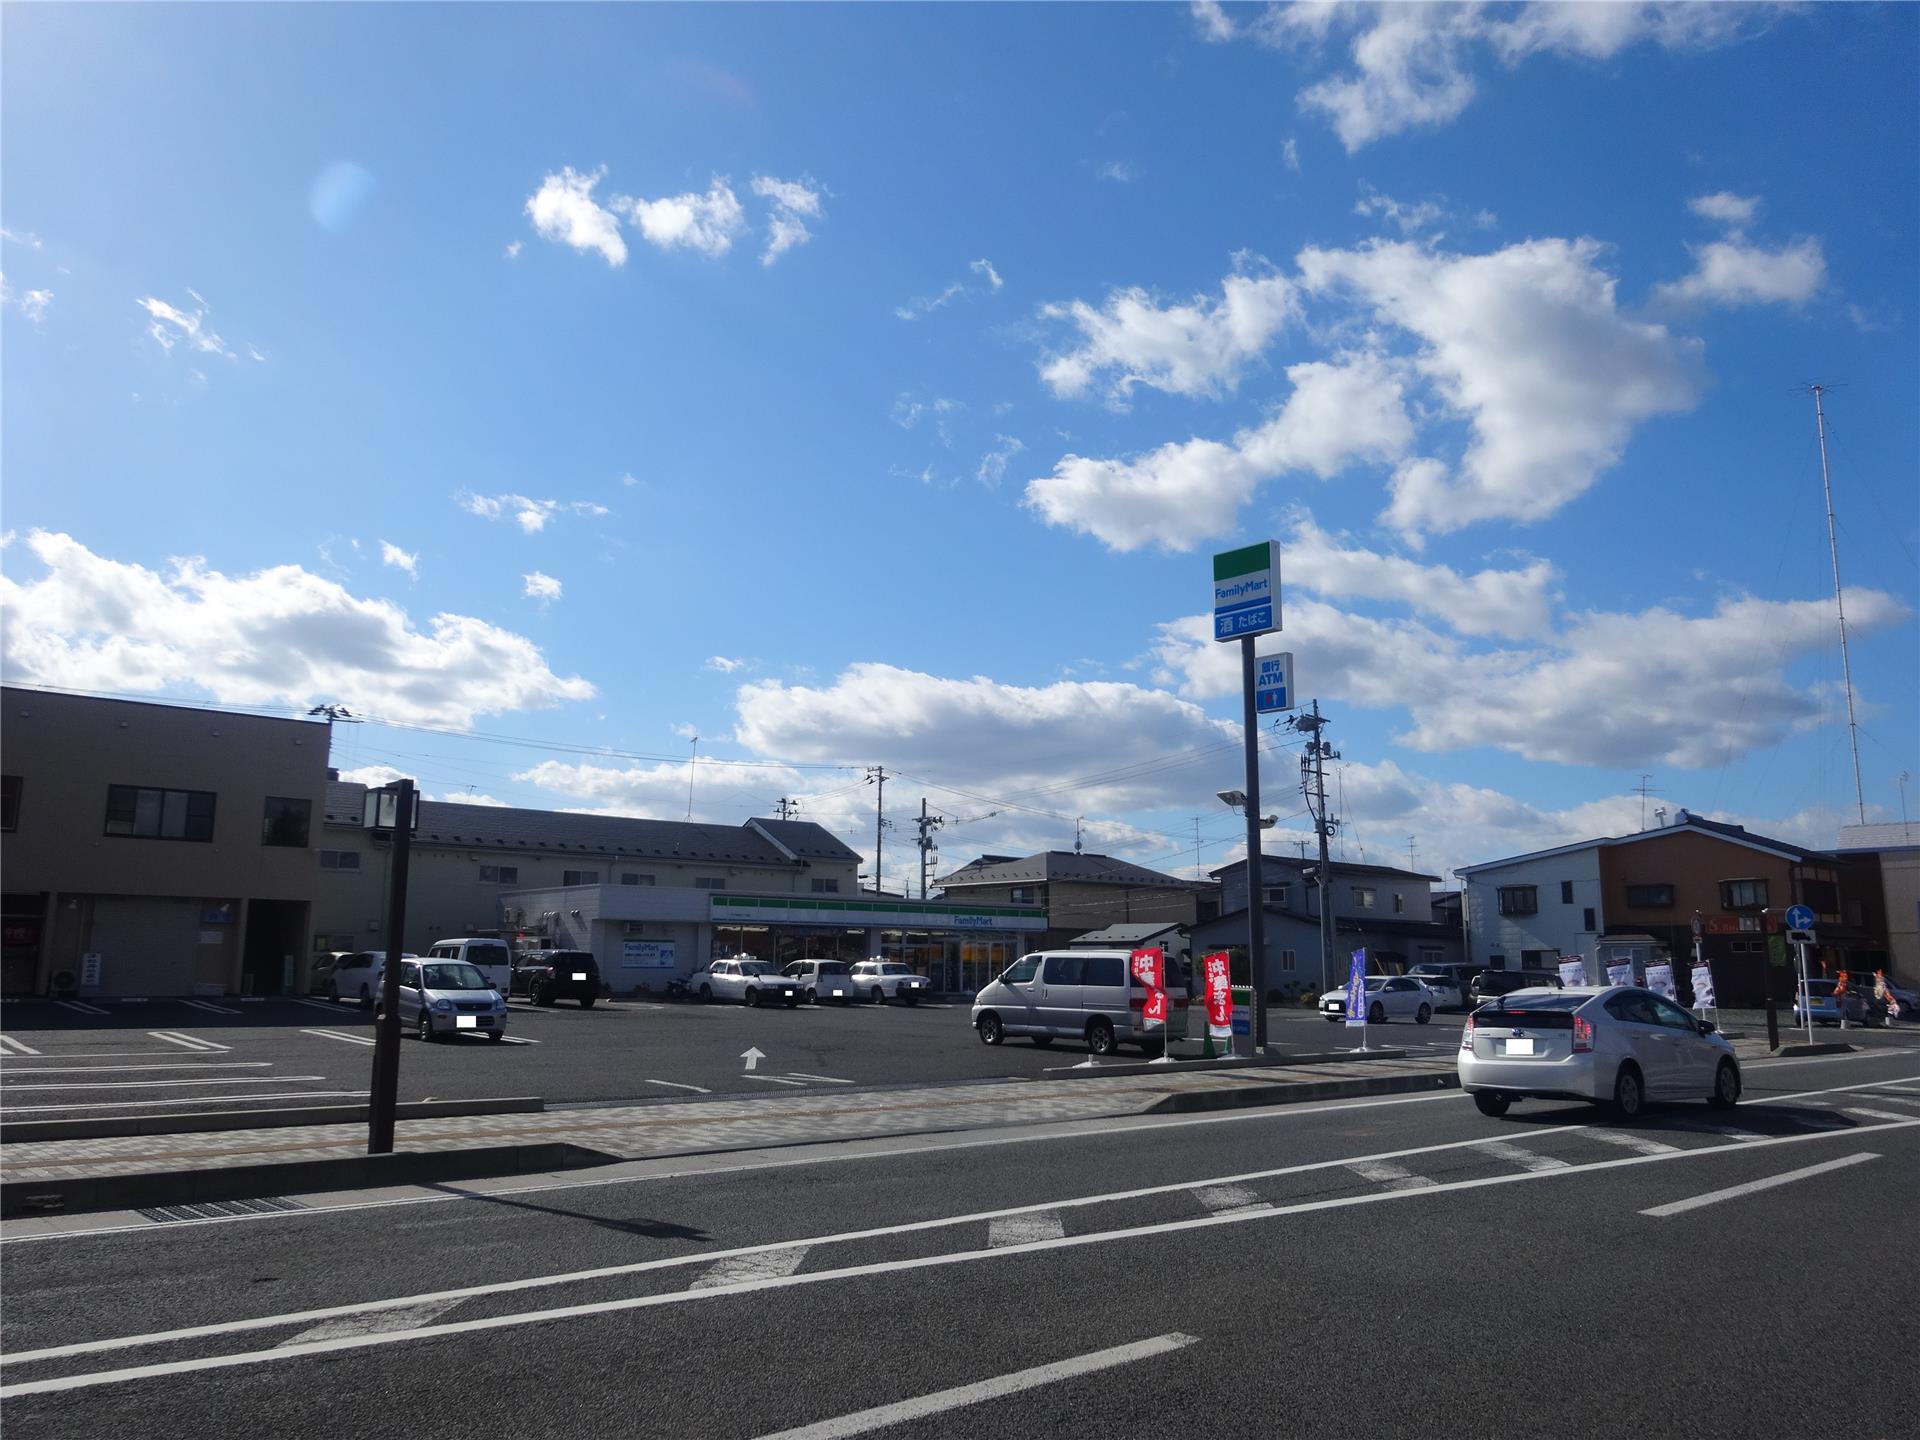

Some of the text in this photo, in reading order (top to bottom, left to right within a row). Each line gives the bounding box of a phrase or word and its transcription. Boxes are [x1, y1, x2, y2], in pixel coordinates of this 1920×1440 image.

[1215, 579, 1267, 599] FamilyMart
[1220, 612, 1267, 633] 酒 たばこ
[1261, 660, 1281, 672] 銀行
[1259, 673, 1283, 687] ATM
[953, 914, 993, 927] FamilyMart
[624, 943, 659, 953] FamilyMart
